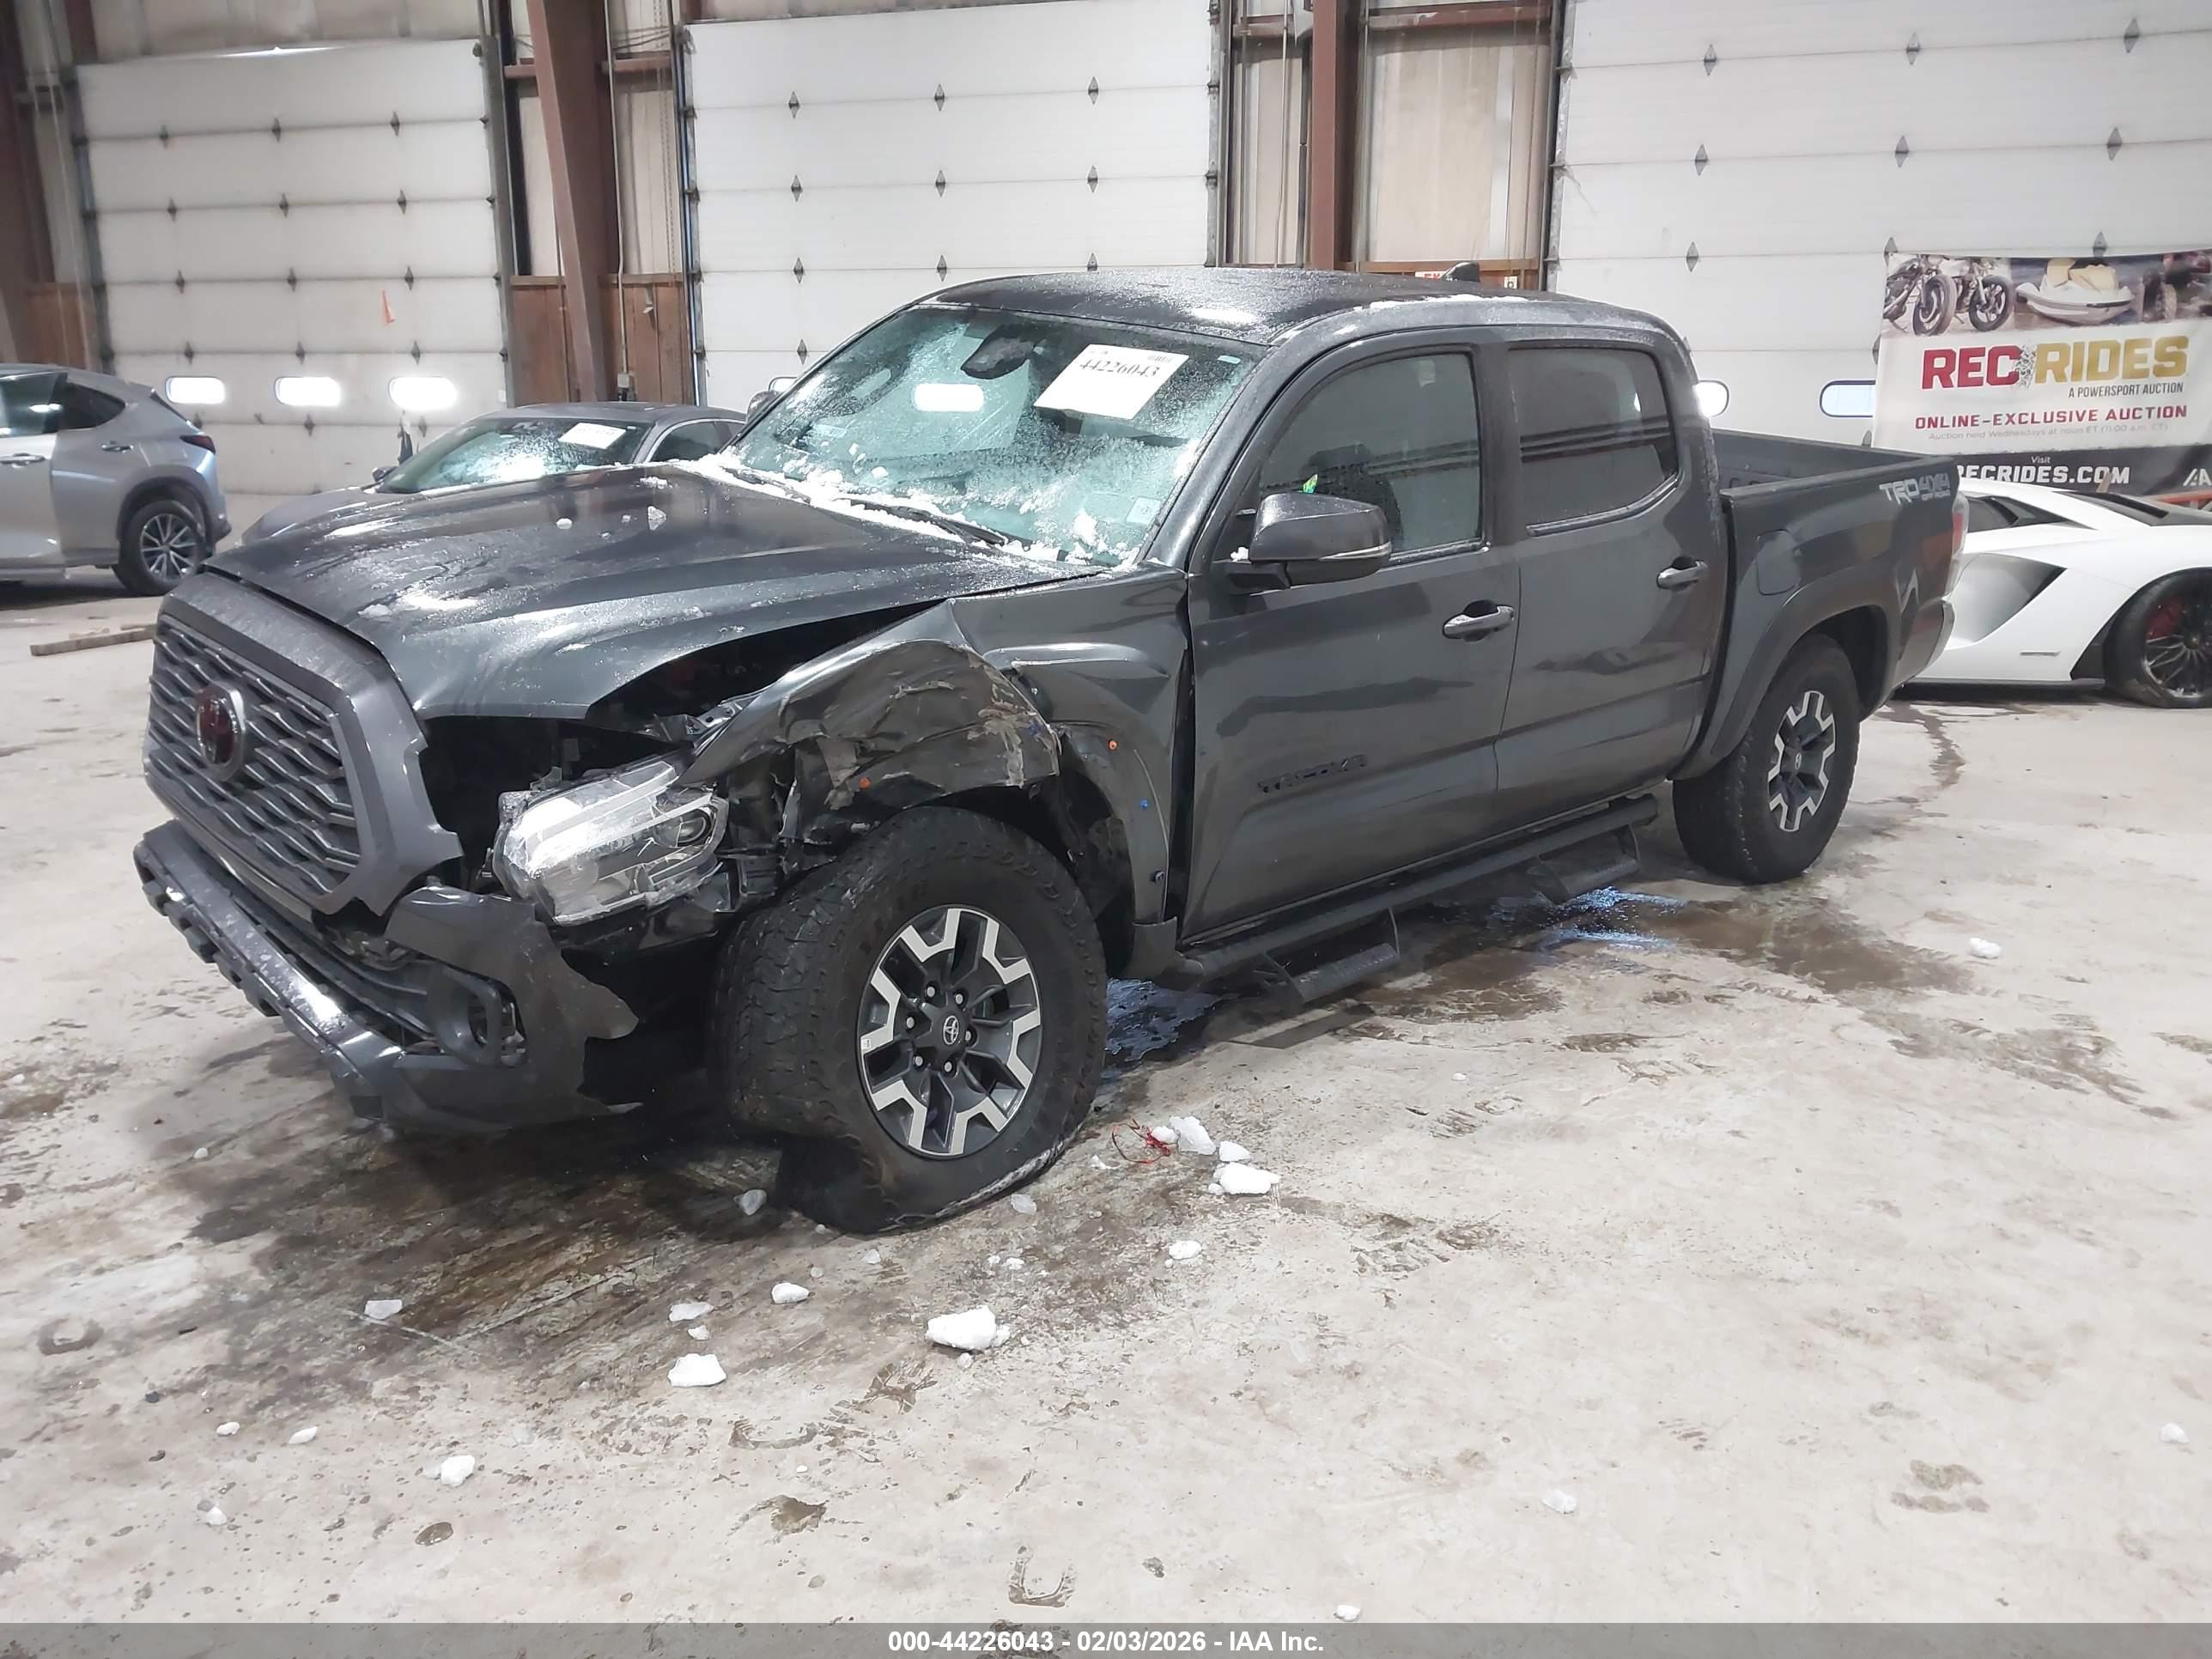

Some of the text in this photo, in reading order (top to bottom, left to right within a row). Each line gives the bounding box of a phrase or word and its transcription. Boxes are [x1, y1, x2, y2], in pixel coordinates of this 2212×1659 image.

[1079, 359, 1161, 378] 44226043
[1922, 335, 2190, 390] REC RIDES
[2068, 382, 2185, 398] A POWERSPORT AUCTION
[1915, 404, 2187, 429] ONLINE-EXCLUSIVE AUCTION
[2030, 455, 2051, 464] Visit
[1878, 478, 1920, 505] TRD
